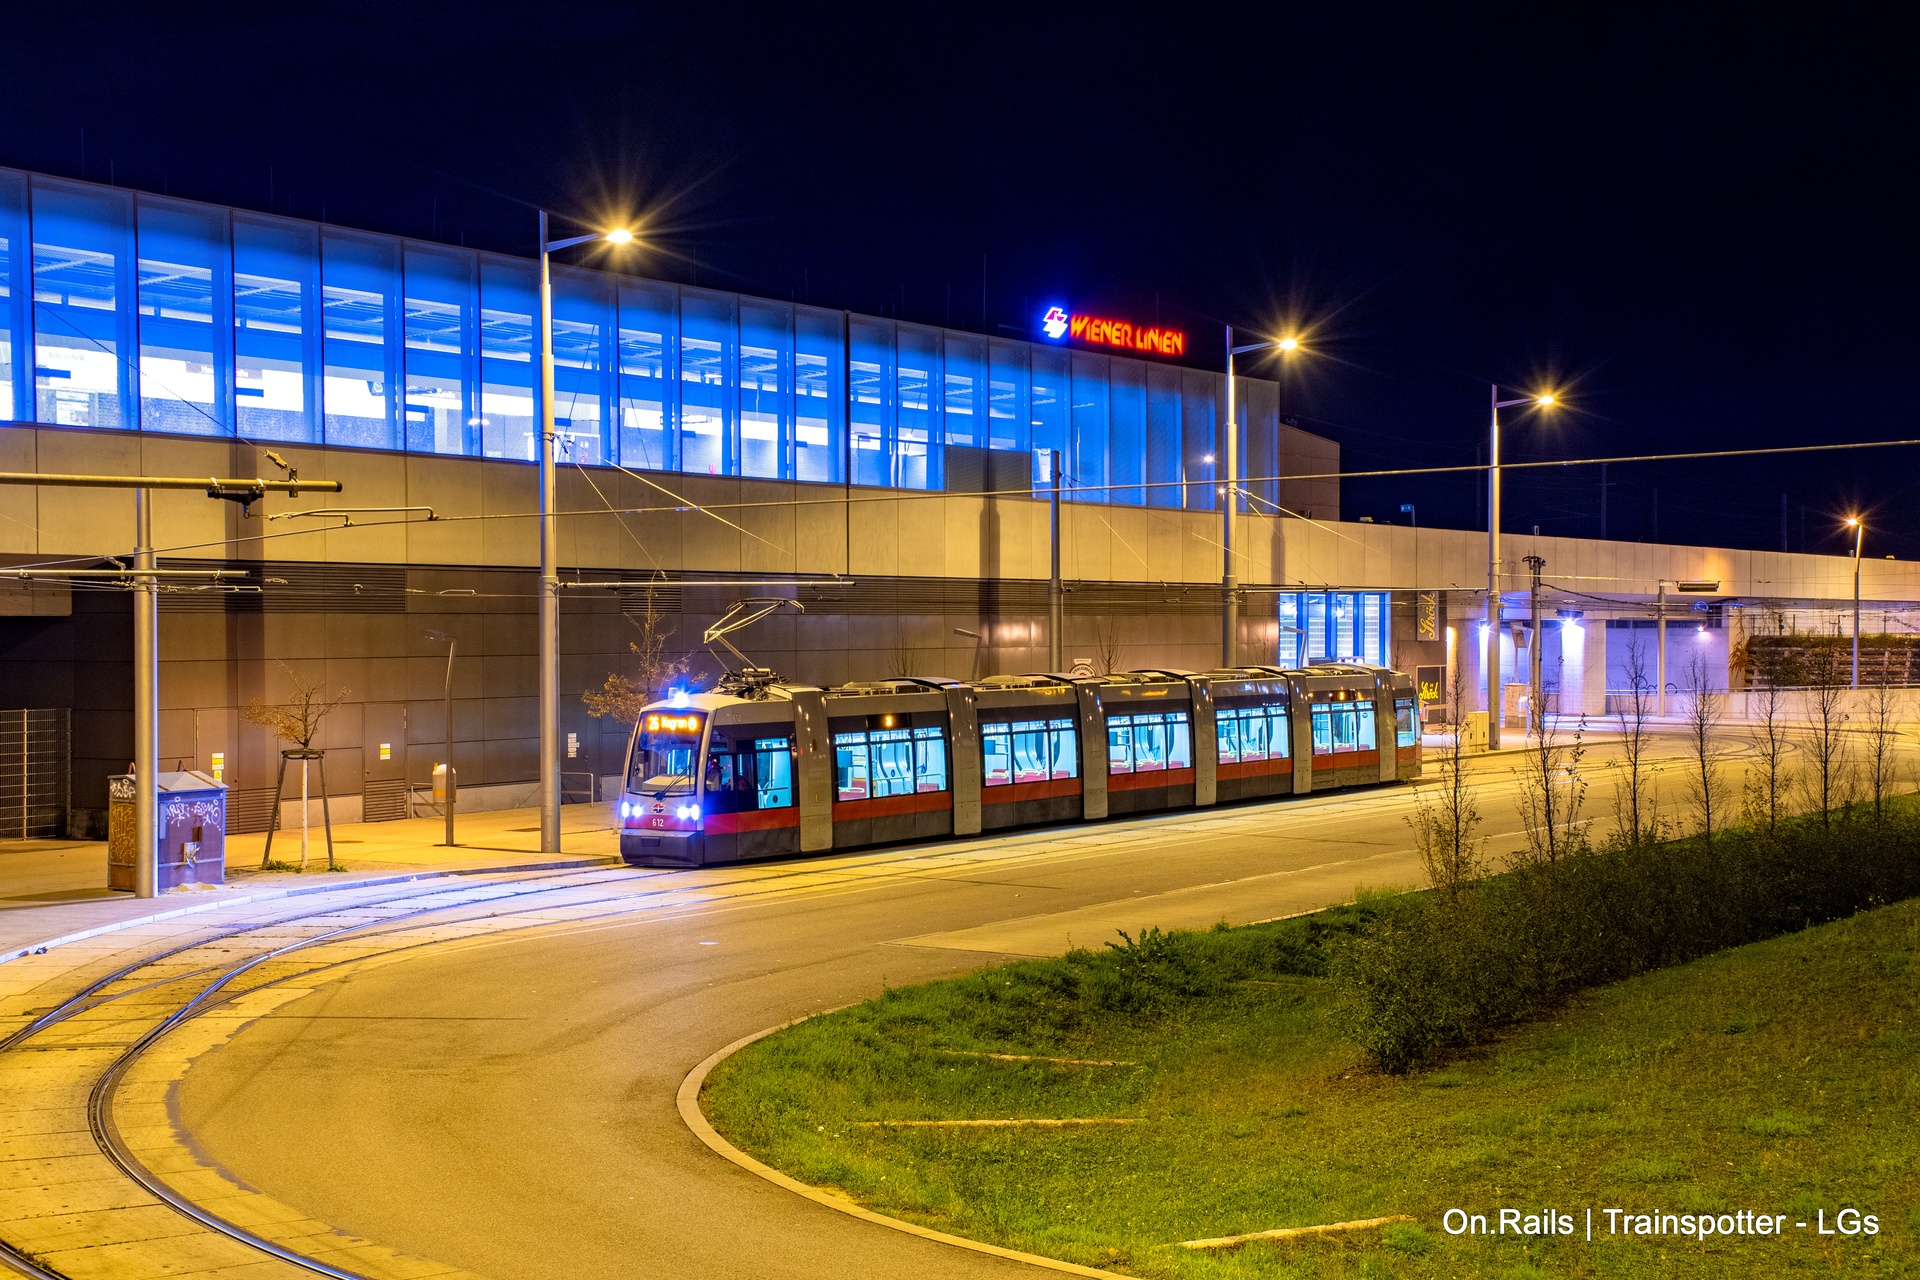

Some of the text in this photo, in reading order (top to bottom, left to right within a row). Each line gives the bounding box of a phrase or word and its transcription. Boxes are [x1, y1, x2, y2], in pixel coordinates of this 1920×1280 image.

[1070, 315, 1183, 355] WIENER LINIEN
[648, 716, 660, 731] 26
[661, 716, 687, 731] Kagran
[652, 818, 664, 827] 612
